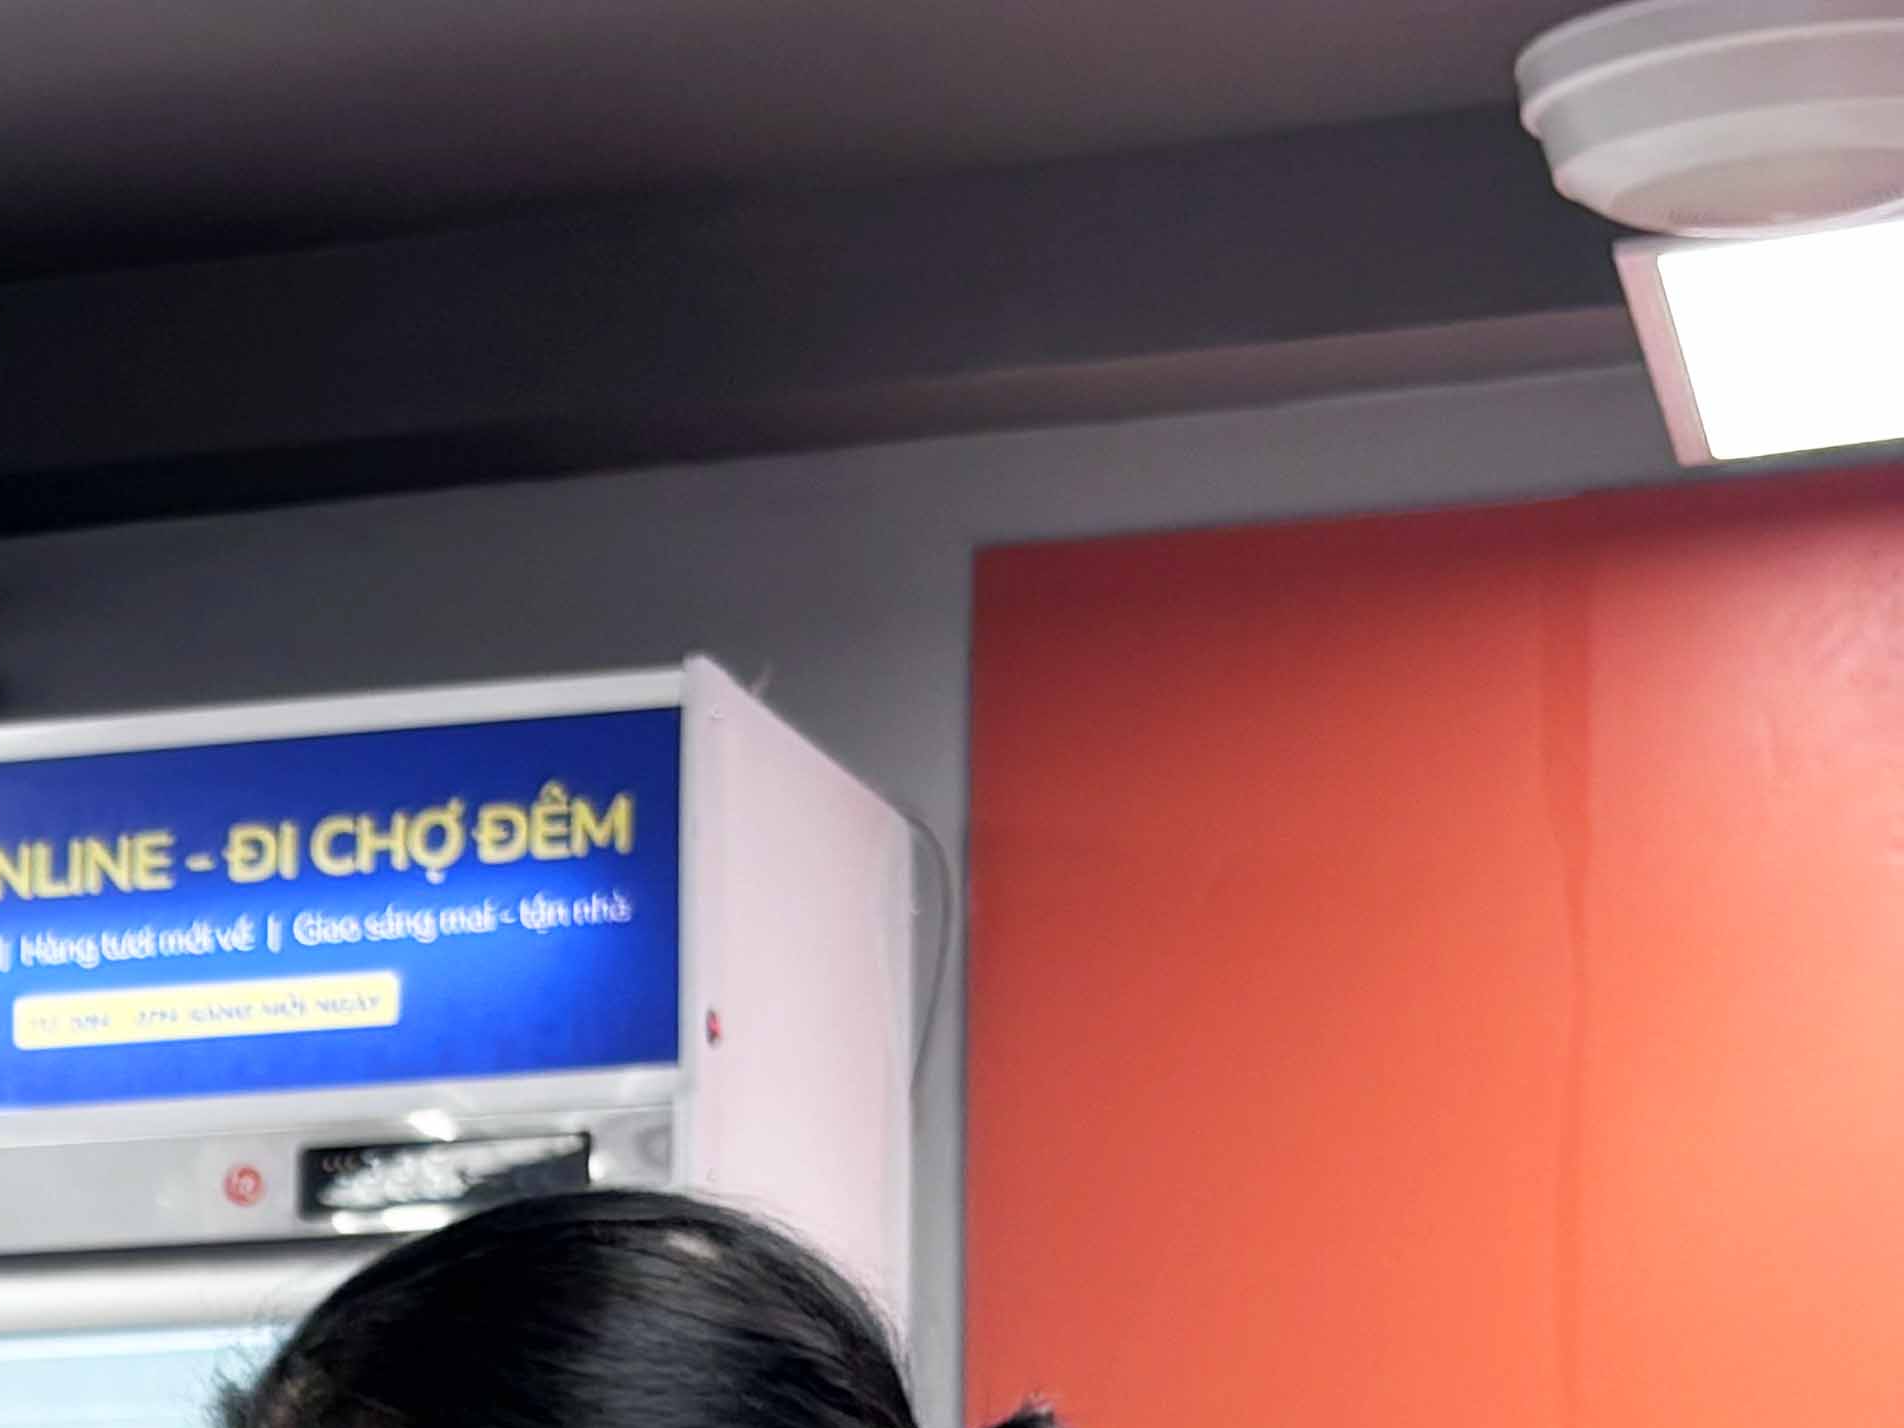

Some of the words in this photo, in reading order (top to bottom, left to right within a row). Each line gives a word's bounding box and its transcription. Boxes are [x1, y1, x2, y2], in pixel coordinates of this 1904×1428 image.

[223, 822, 299, 883] ĐI
[309, 797, 465, 883] CHỢ
[473, 779, 635, 864] ĐÊM
[293, 912, 359, 946] Giao
